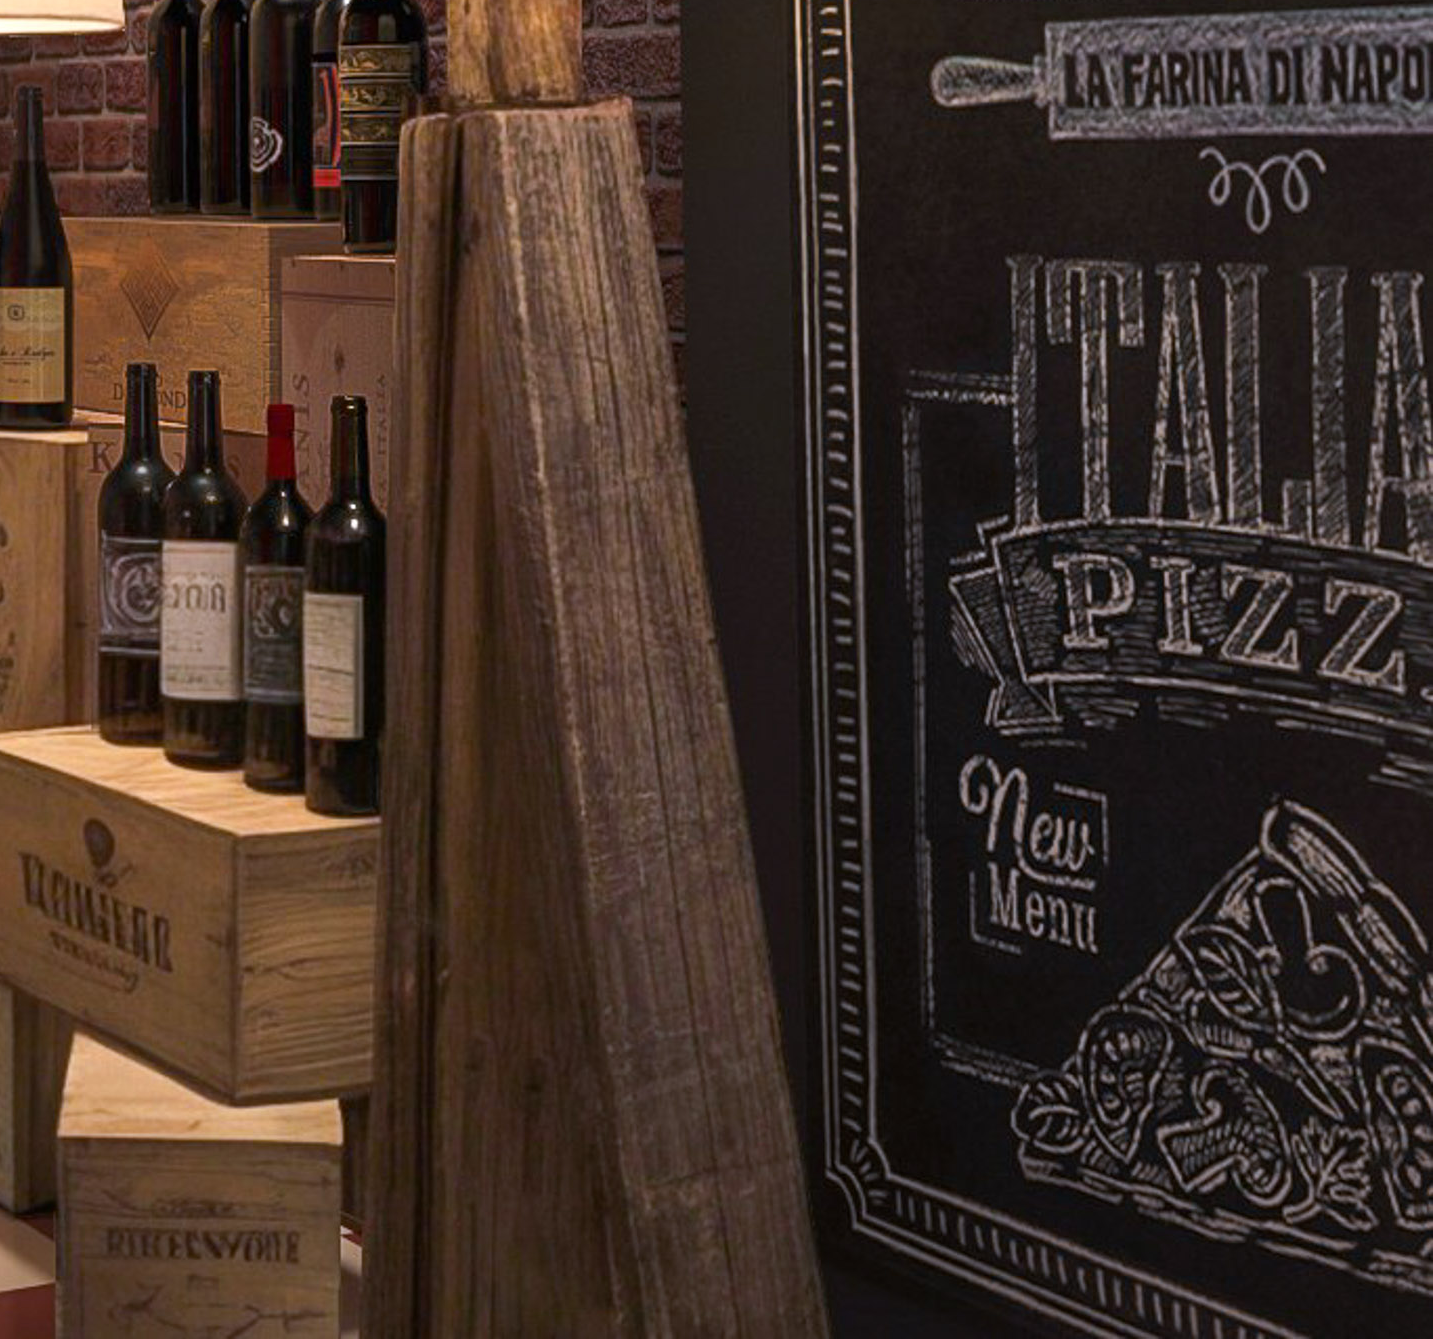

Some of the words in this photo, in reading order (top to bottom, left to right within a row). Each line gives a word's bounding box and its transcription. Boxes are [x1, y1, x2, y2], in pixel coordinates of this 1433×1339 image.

[1063, 53, 1111, 109] LA
[1124, 48, 1251, 107] FARINA
[1269, 46, 1304, 105] DI
[1319, 41, 1433, 106] NAPO
[1053, 553, 1433, 701] PIZZ
[959, 754, 1097, 888] New
[988, 861, 1099, 955] Menu
